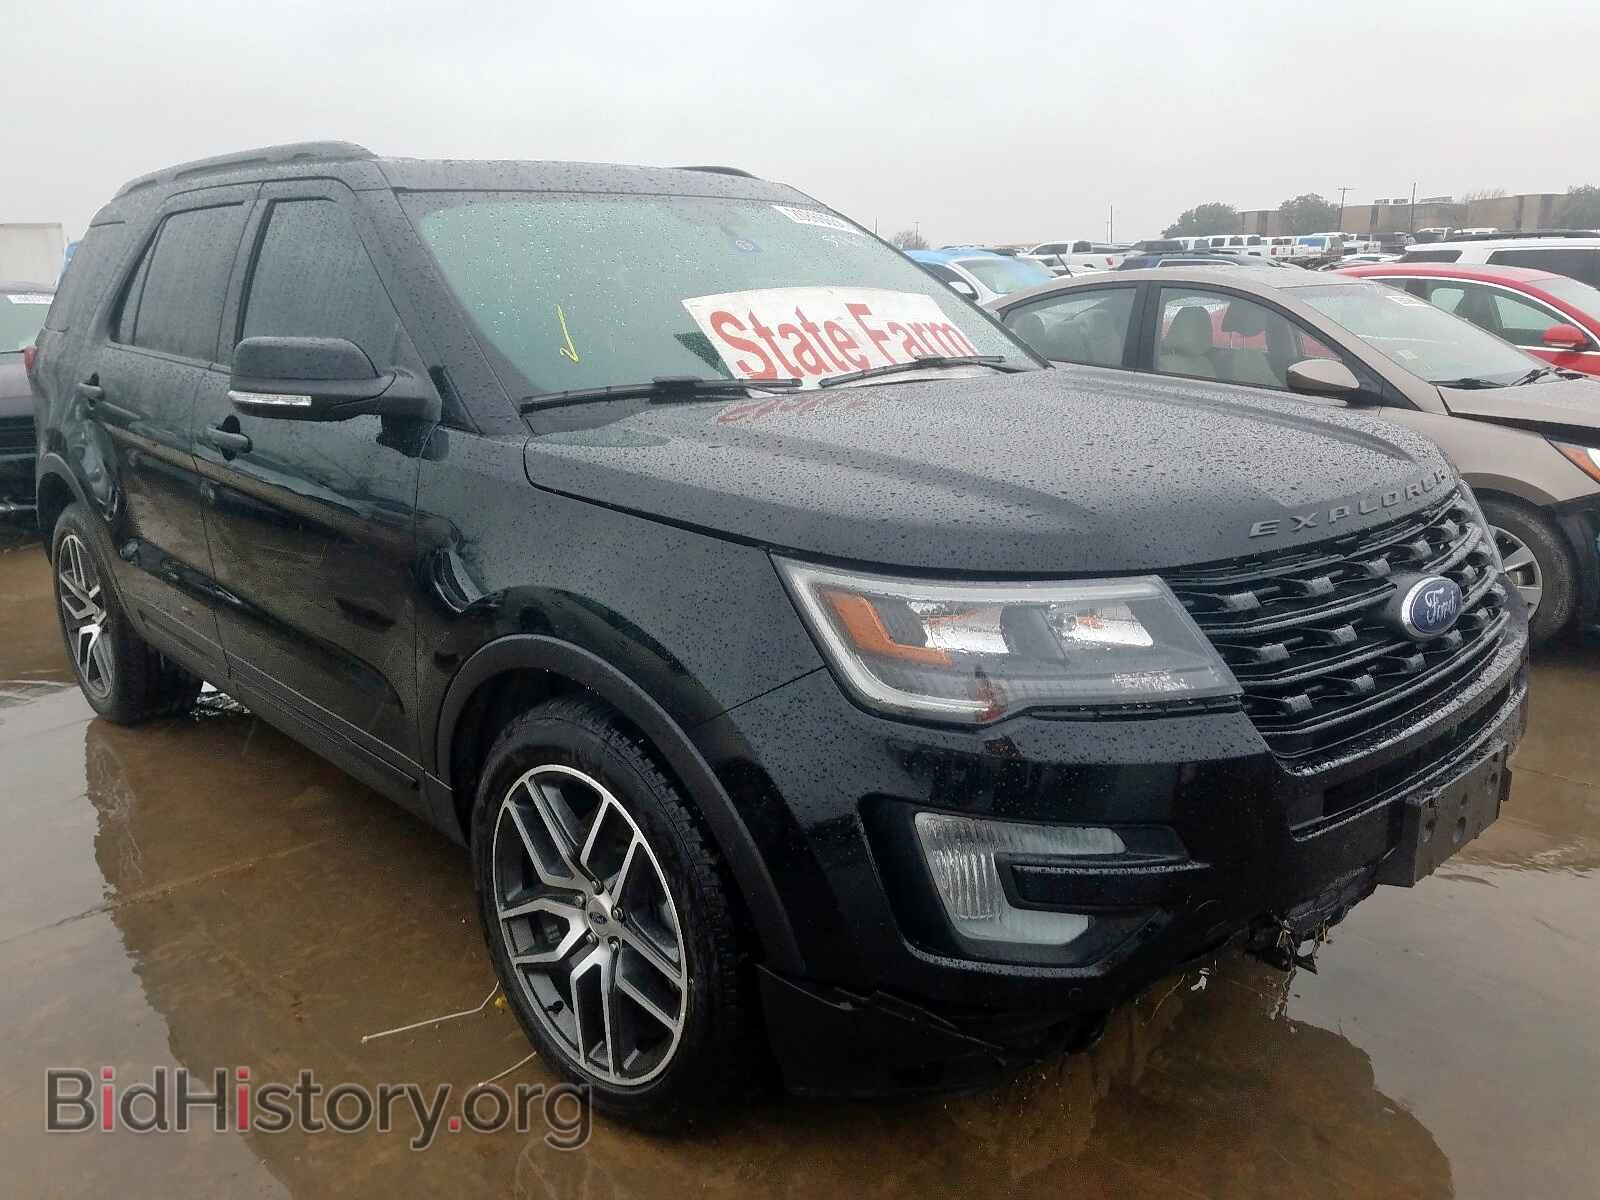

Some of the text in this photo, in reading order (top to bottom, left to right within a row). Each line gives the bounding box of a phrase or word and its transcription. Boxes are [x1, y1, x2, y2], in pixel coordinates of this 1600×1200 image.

[711, 303, 980, 380] State Farm
[1424, 587, 1457, 625] Ford
